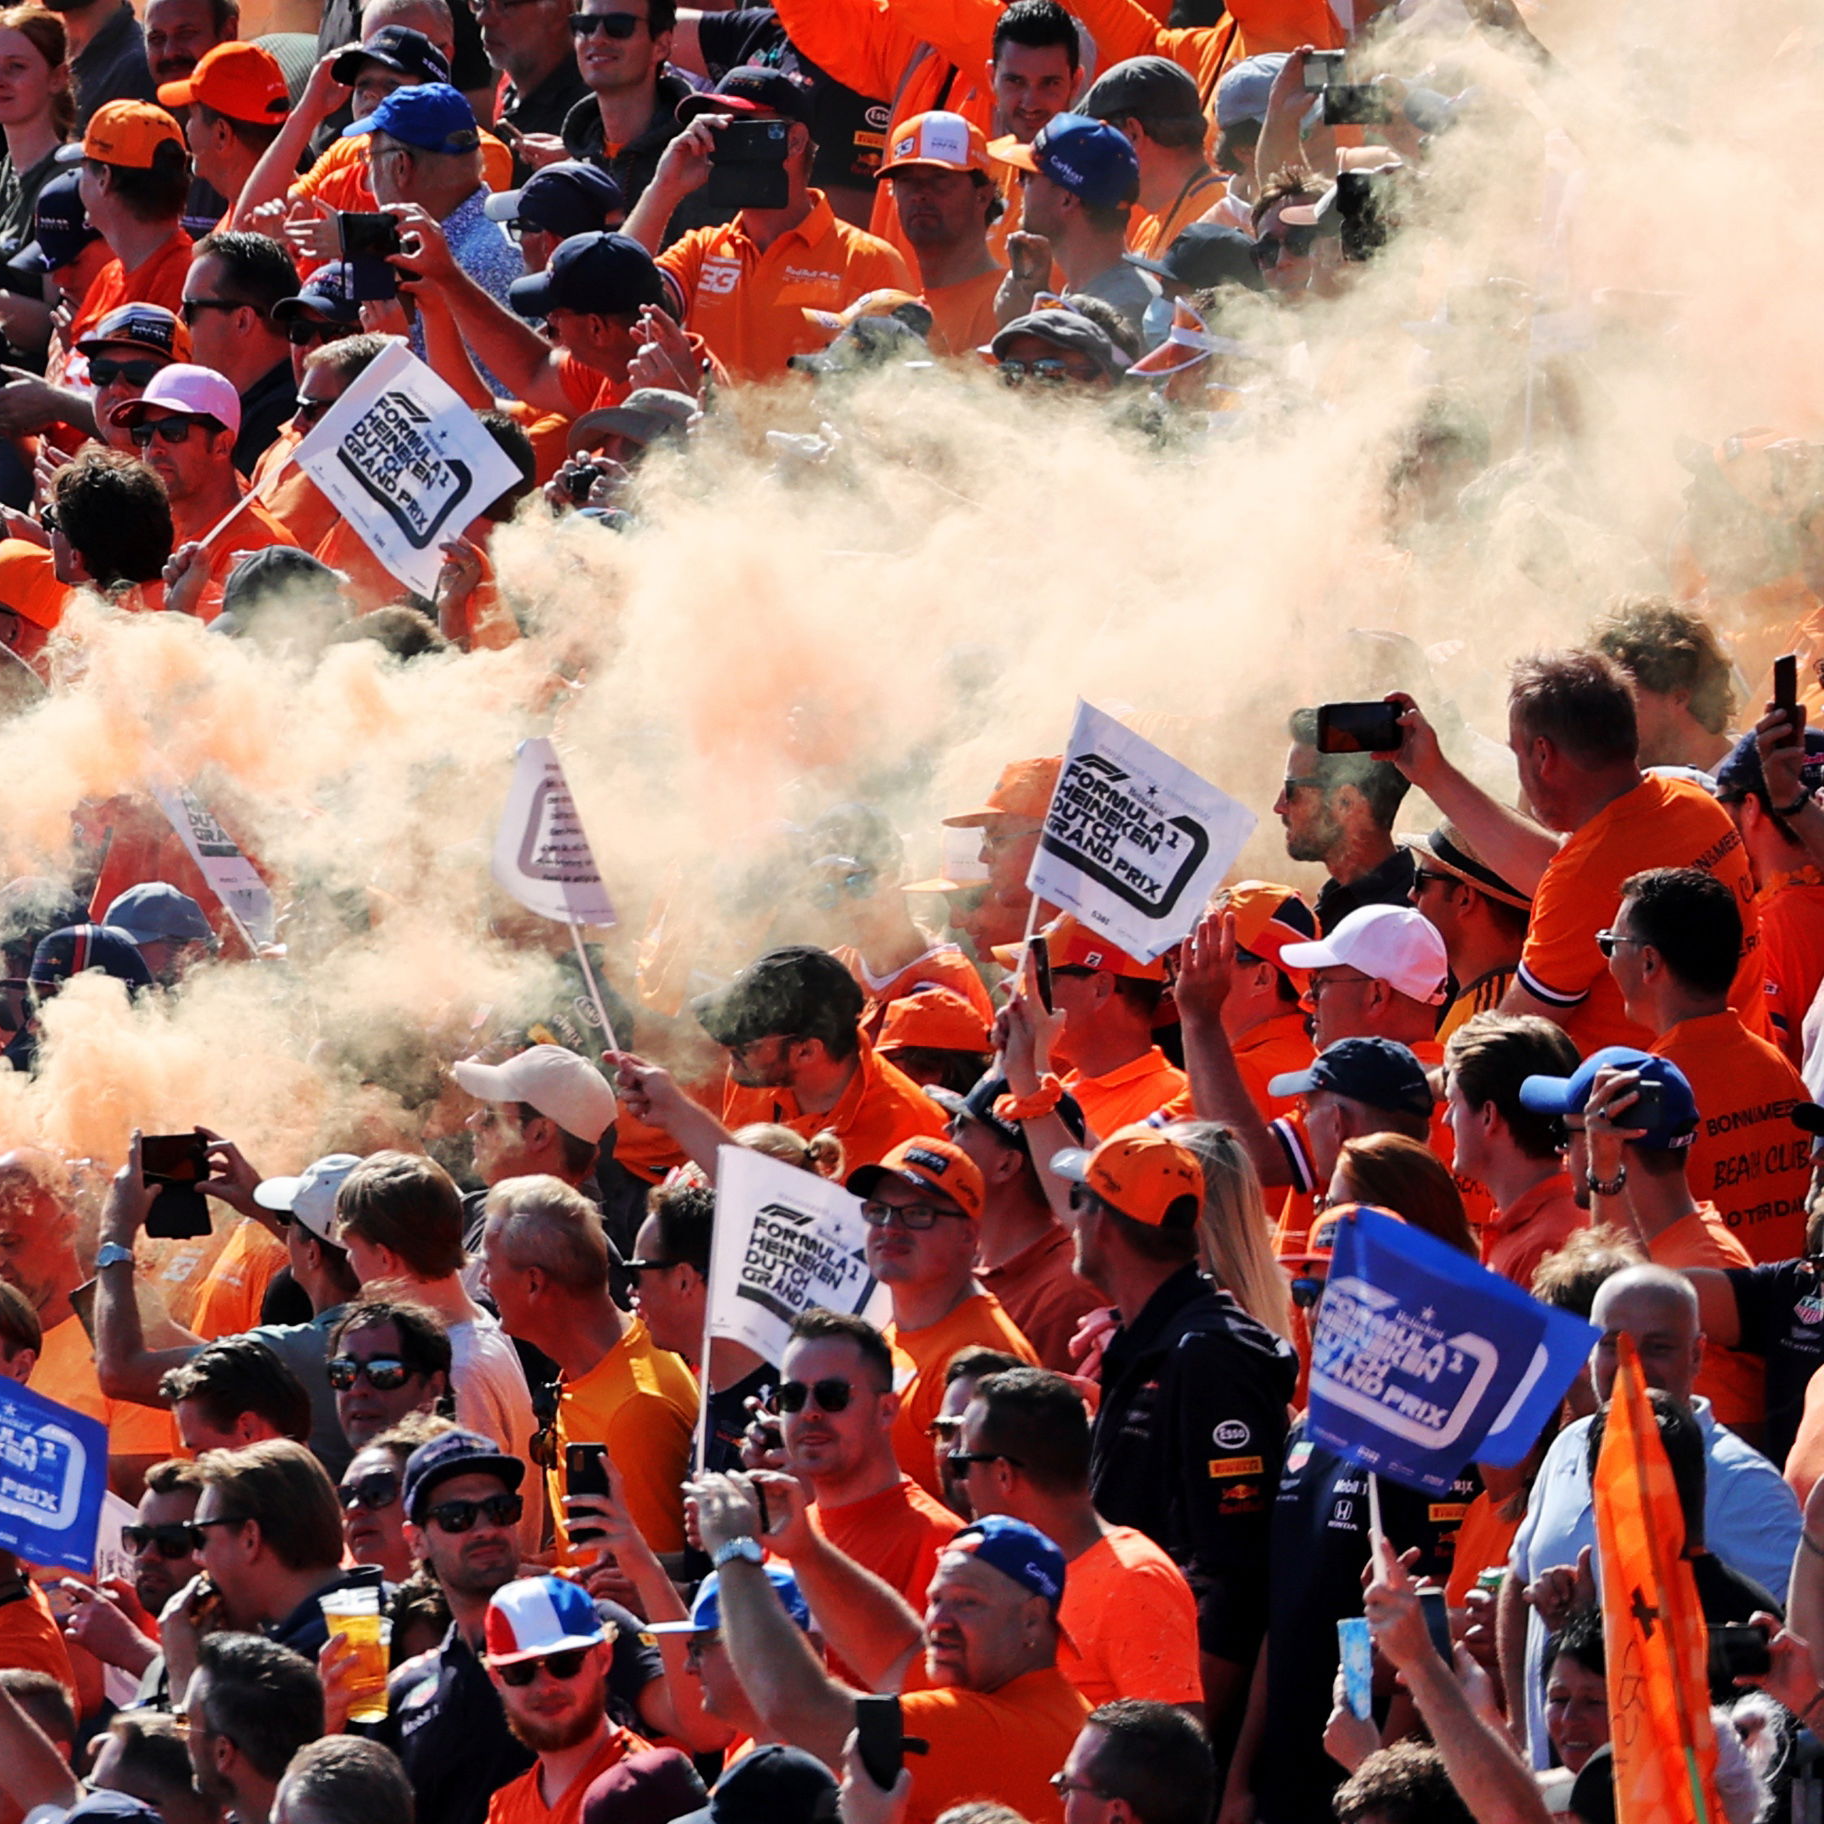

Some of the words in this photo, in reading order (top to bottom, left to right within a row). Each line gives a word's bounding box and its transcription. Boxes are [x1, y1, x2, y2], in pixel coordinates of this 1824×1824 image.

[698, 263, 741, 293] 33
[352, 420, 402, 477] DUTCH
[364, 409, 435, 490] HEINEKEN
[375, 397, 441, 478] FORMULA
[439, 471, 450, 487] 1
[344, 434, 397, 493] GRAND
[396, 493, 428, 530] PRIX
[1050, 798, 1119, 848] DUTCH
[1058, 784, 1160, 855] HEINEKEN
[1064, 763, 1167, 835] FORMULA
[1167, 832, 1179, 849] 1
[1046, 816, 1112, 867] GRAND
[1115, 858, 1162, 902] PRIX
[745, 1251, 810, 1290] DUTCH
[750, 1234, 840, 1290] HEINEKEN
[753, 1217, 848, 1272] FORMULA
[849, 1265, 859, 1280] 1
[742, 1266, 803, 1307] GRAND
[1448, 1352, 1463, 1372] 1
[1219, 1423, 1244, 1436] Esso
[1384, 1382, 1448, 1429] PRIX
[42, 1445, 56, 1460] 1
[0, 1480, 58, 1512] PRIX
